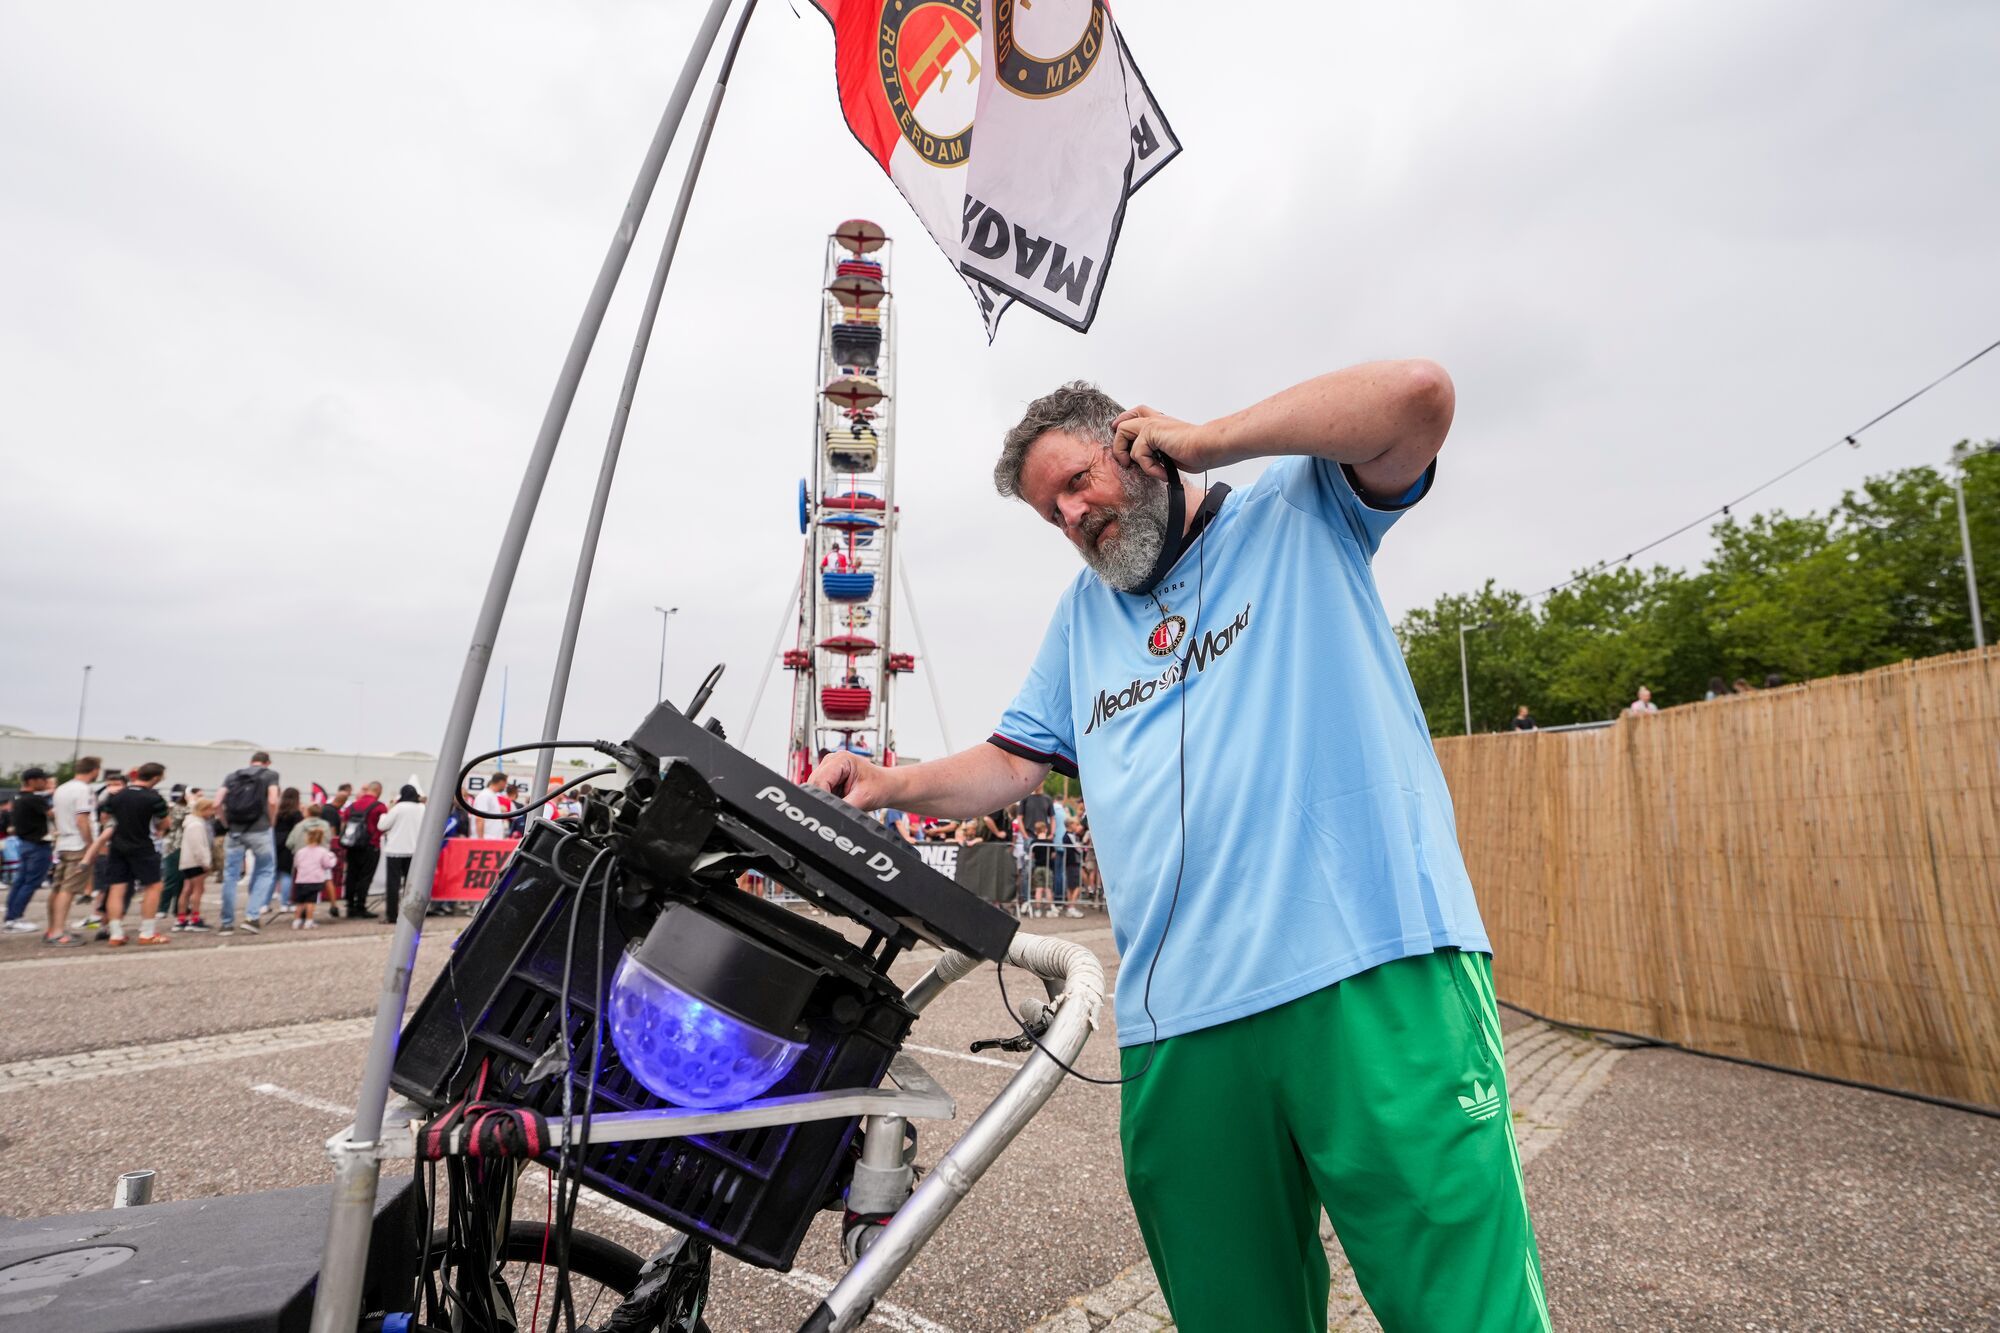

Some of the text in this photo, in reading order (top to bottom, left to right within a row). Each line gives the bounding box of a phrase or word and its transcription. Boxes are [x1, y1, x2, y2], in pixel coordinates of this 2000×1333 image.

[881, 24, 964, 160] ROTTERDAM
[1144, 581, 1185, 609] CTORE
[1084, 602, 1251, 735] Media Markt
[755, 786, 901, 882] Pioneer DJ
